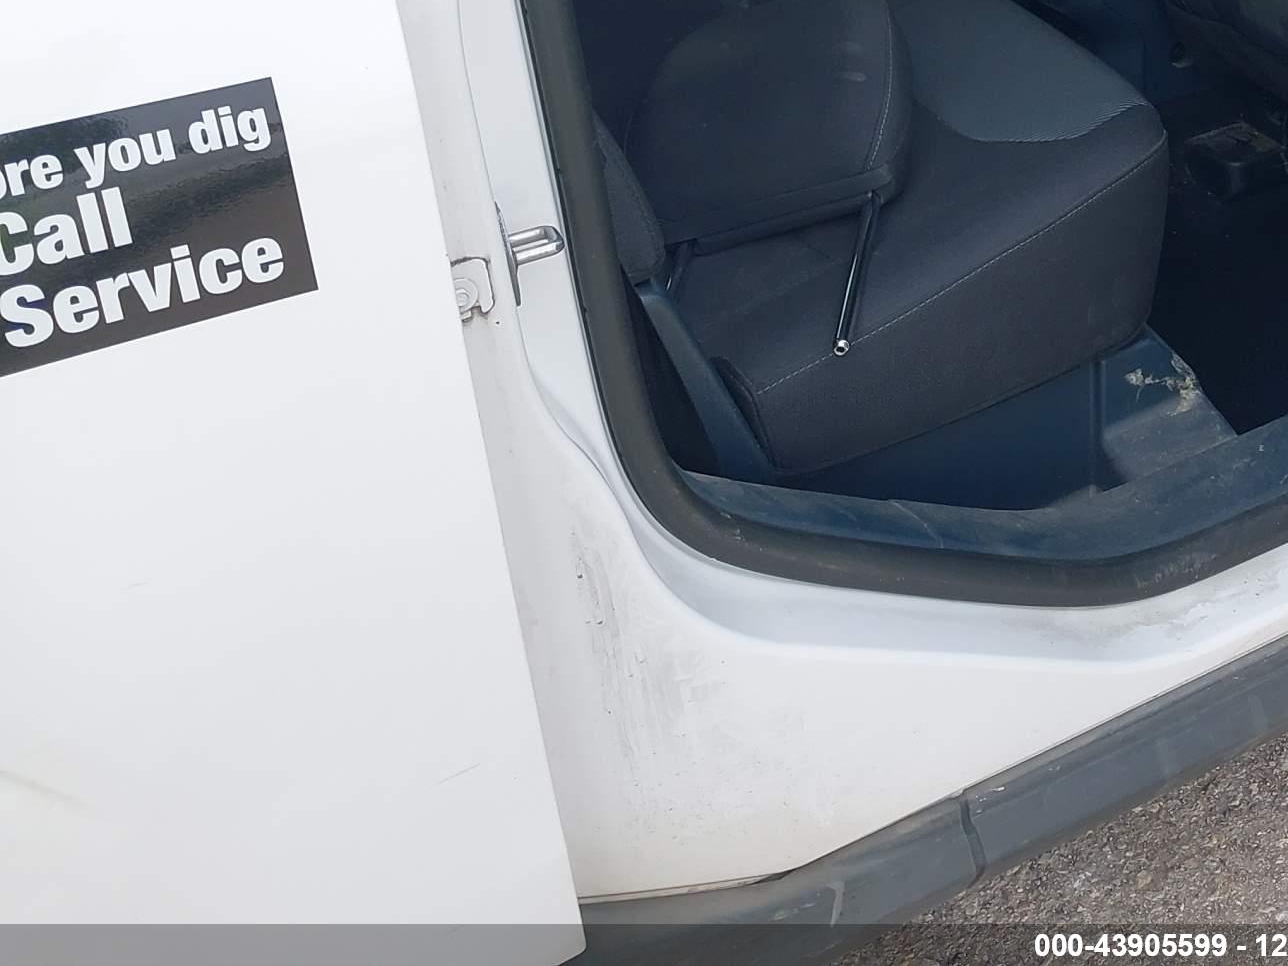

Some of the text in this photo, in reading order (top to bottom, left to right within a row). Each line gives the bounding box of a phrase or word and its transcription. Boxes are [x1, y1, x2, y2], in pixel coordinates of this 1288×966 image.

[0, 105, 272, 200] re you dig
[0, 186, 134, 277] Call
[0, 237, 285, 348] Service
